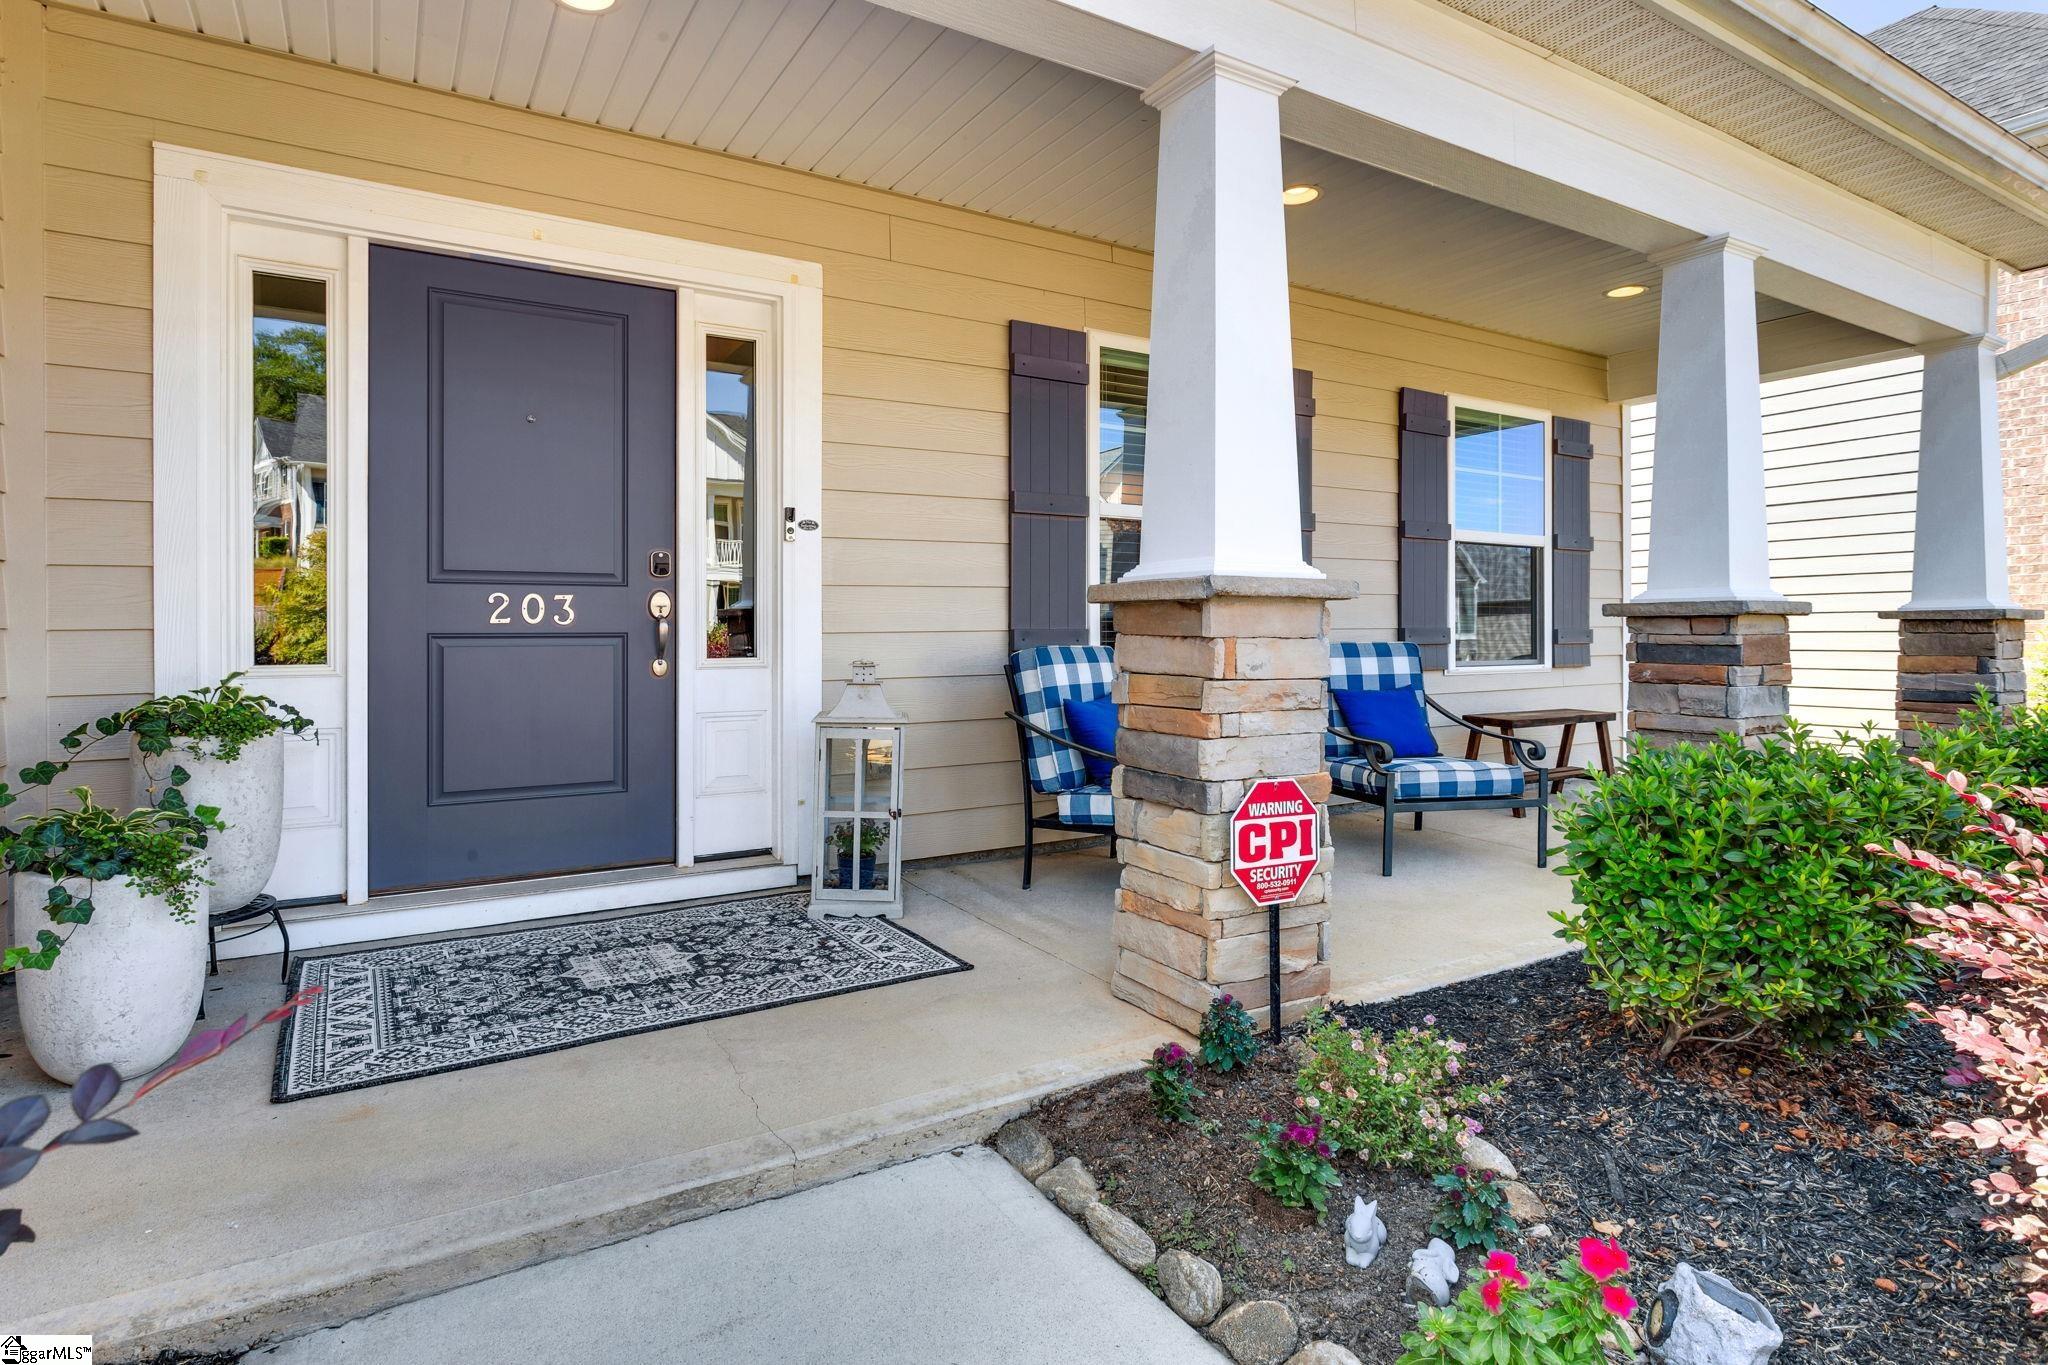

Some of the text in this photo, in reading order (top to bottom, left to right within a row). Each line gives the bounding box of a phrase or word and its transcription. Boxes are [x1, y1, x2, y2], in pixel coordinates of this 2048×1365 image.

[488, 592, 575, 625] 203
[1248, 800, 1303, 816] WARNING
[1238, 819, 1313, 863] CPI
[1250, 864, 1301, 882] SECURITY
[1256, 878, 1297, 890] 800-532-0911
